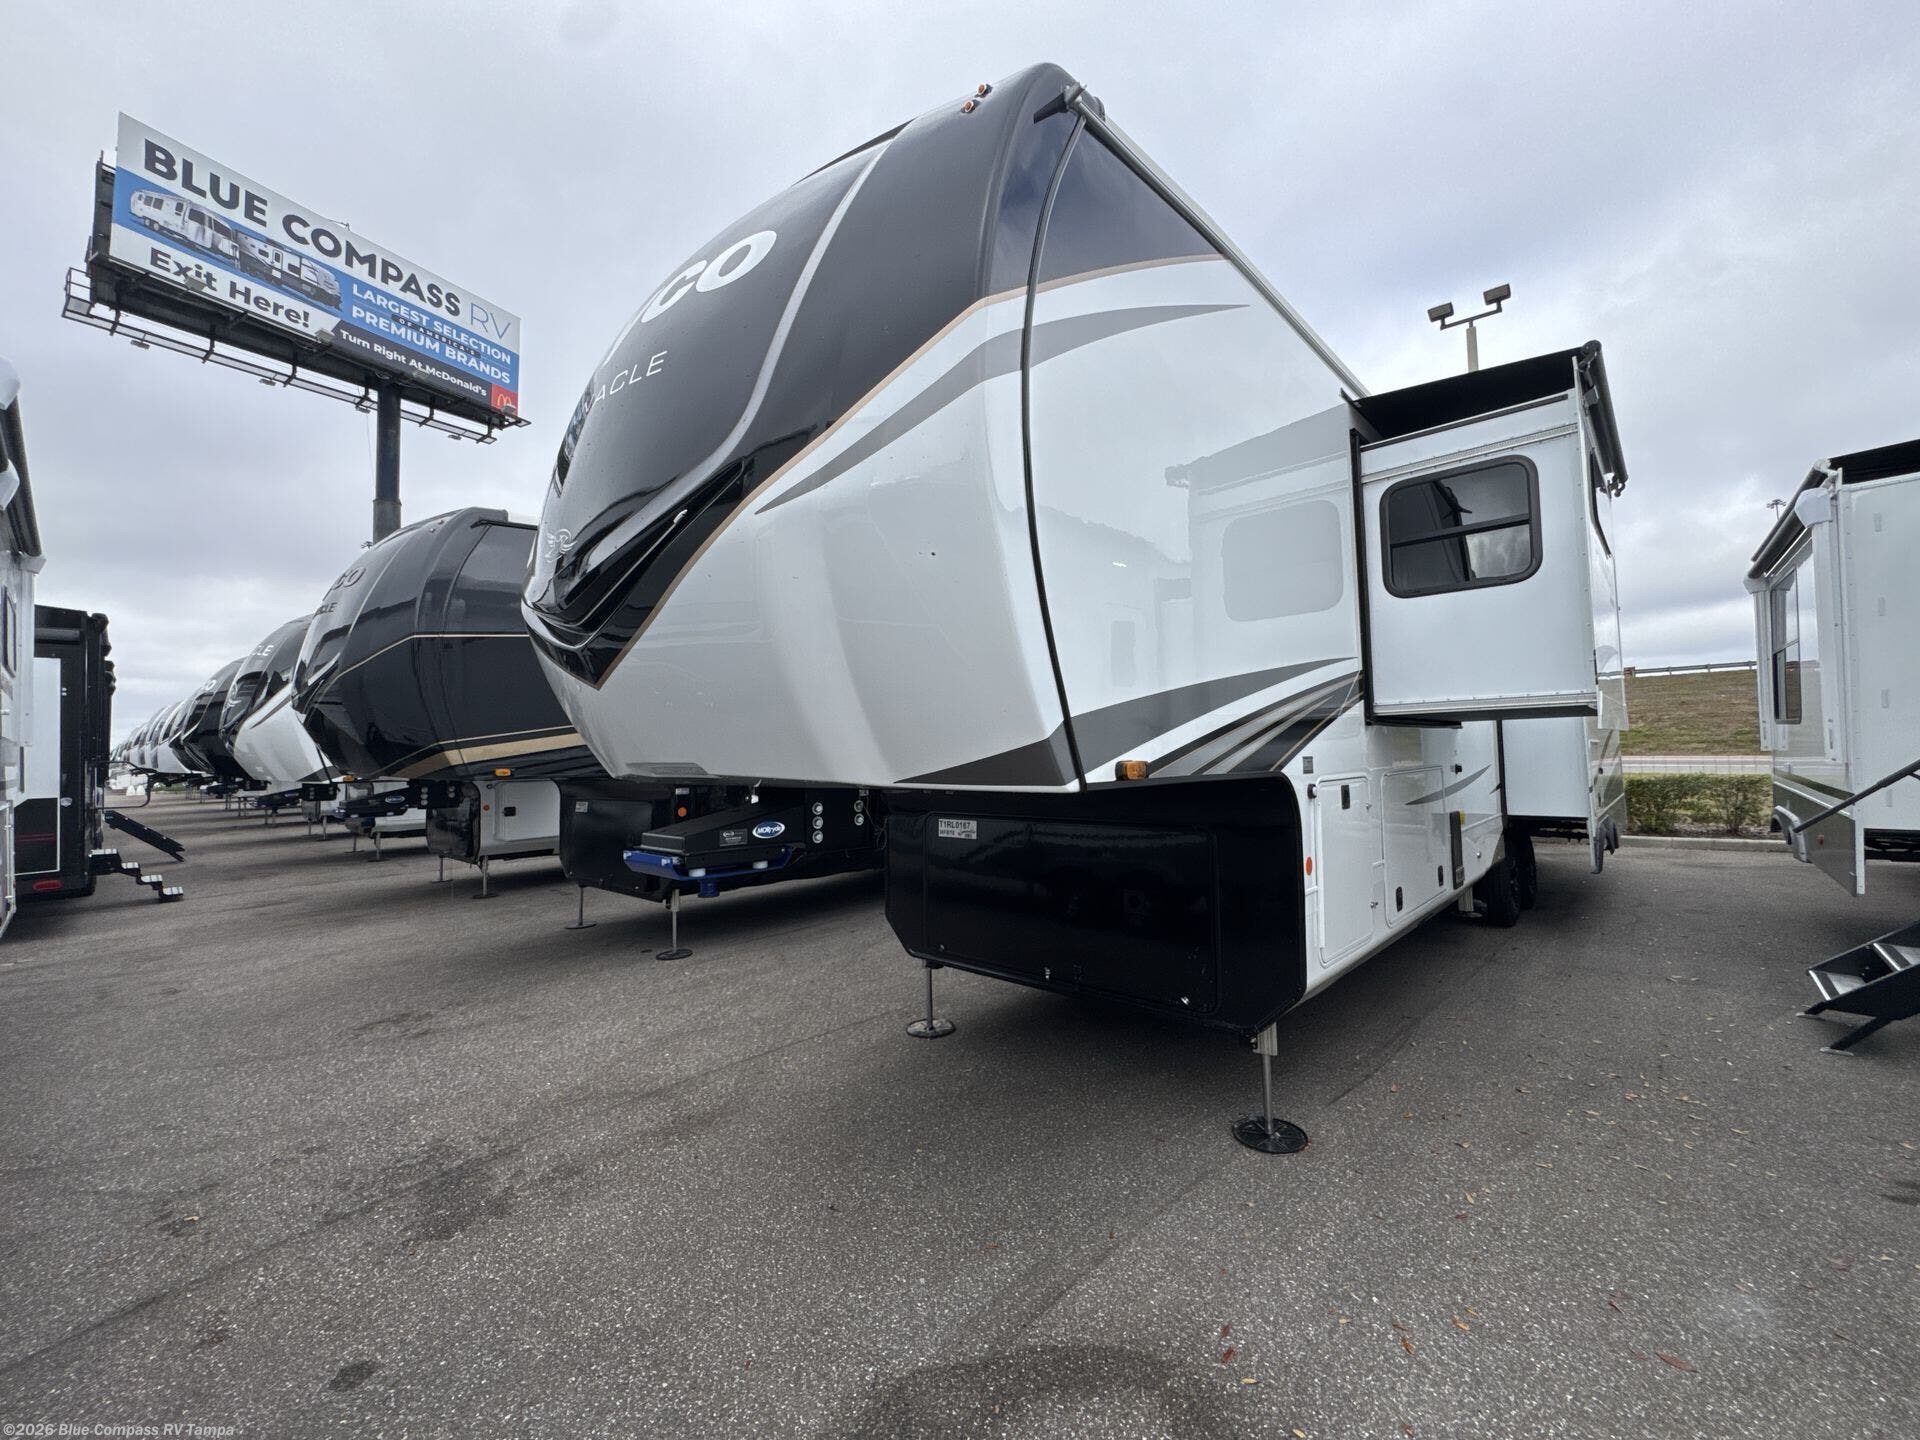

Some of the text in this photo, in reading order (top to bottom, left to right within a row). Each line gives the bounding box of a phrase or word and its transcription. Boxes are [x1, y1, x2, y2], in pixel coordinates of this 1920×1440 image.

[144, 138, 511, 339] BLUE COMPASS RV
[150, 247, 310, 328] Exit Here!
[352, 283, 511, 365] LARGEST SELECTION
[620, 230, 778, 344] CO
[340, 330, 371, 350] Turn
[373, 343, 407, 364] Right
[424, 364, 487, 397] McDonald's
[352, 304, 511, 385] PREMIUM BRANDS
